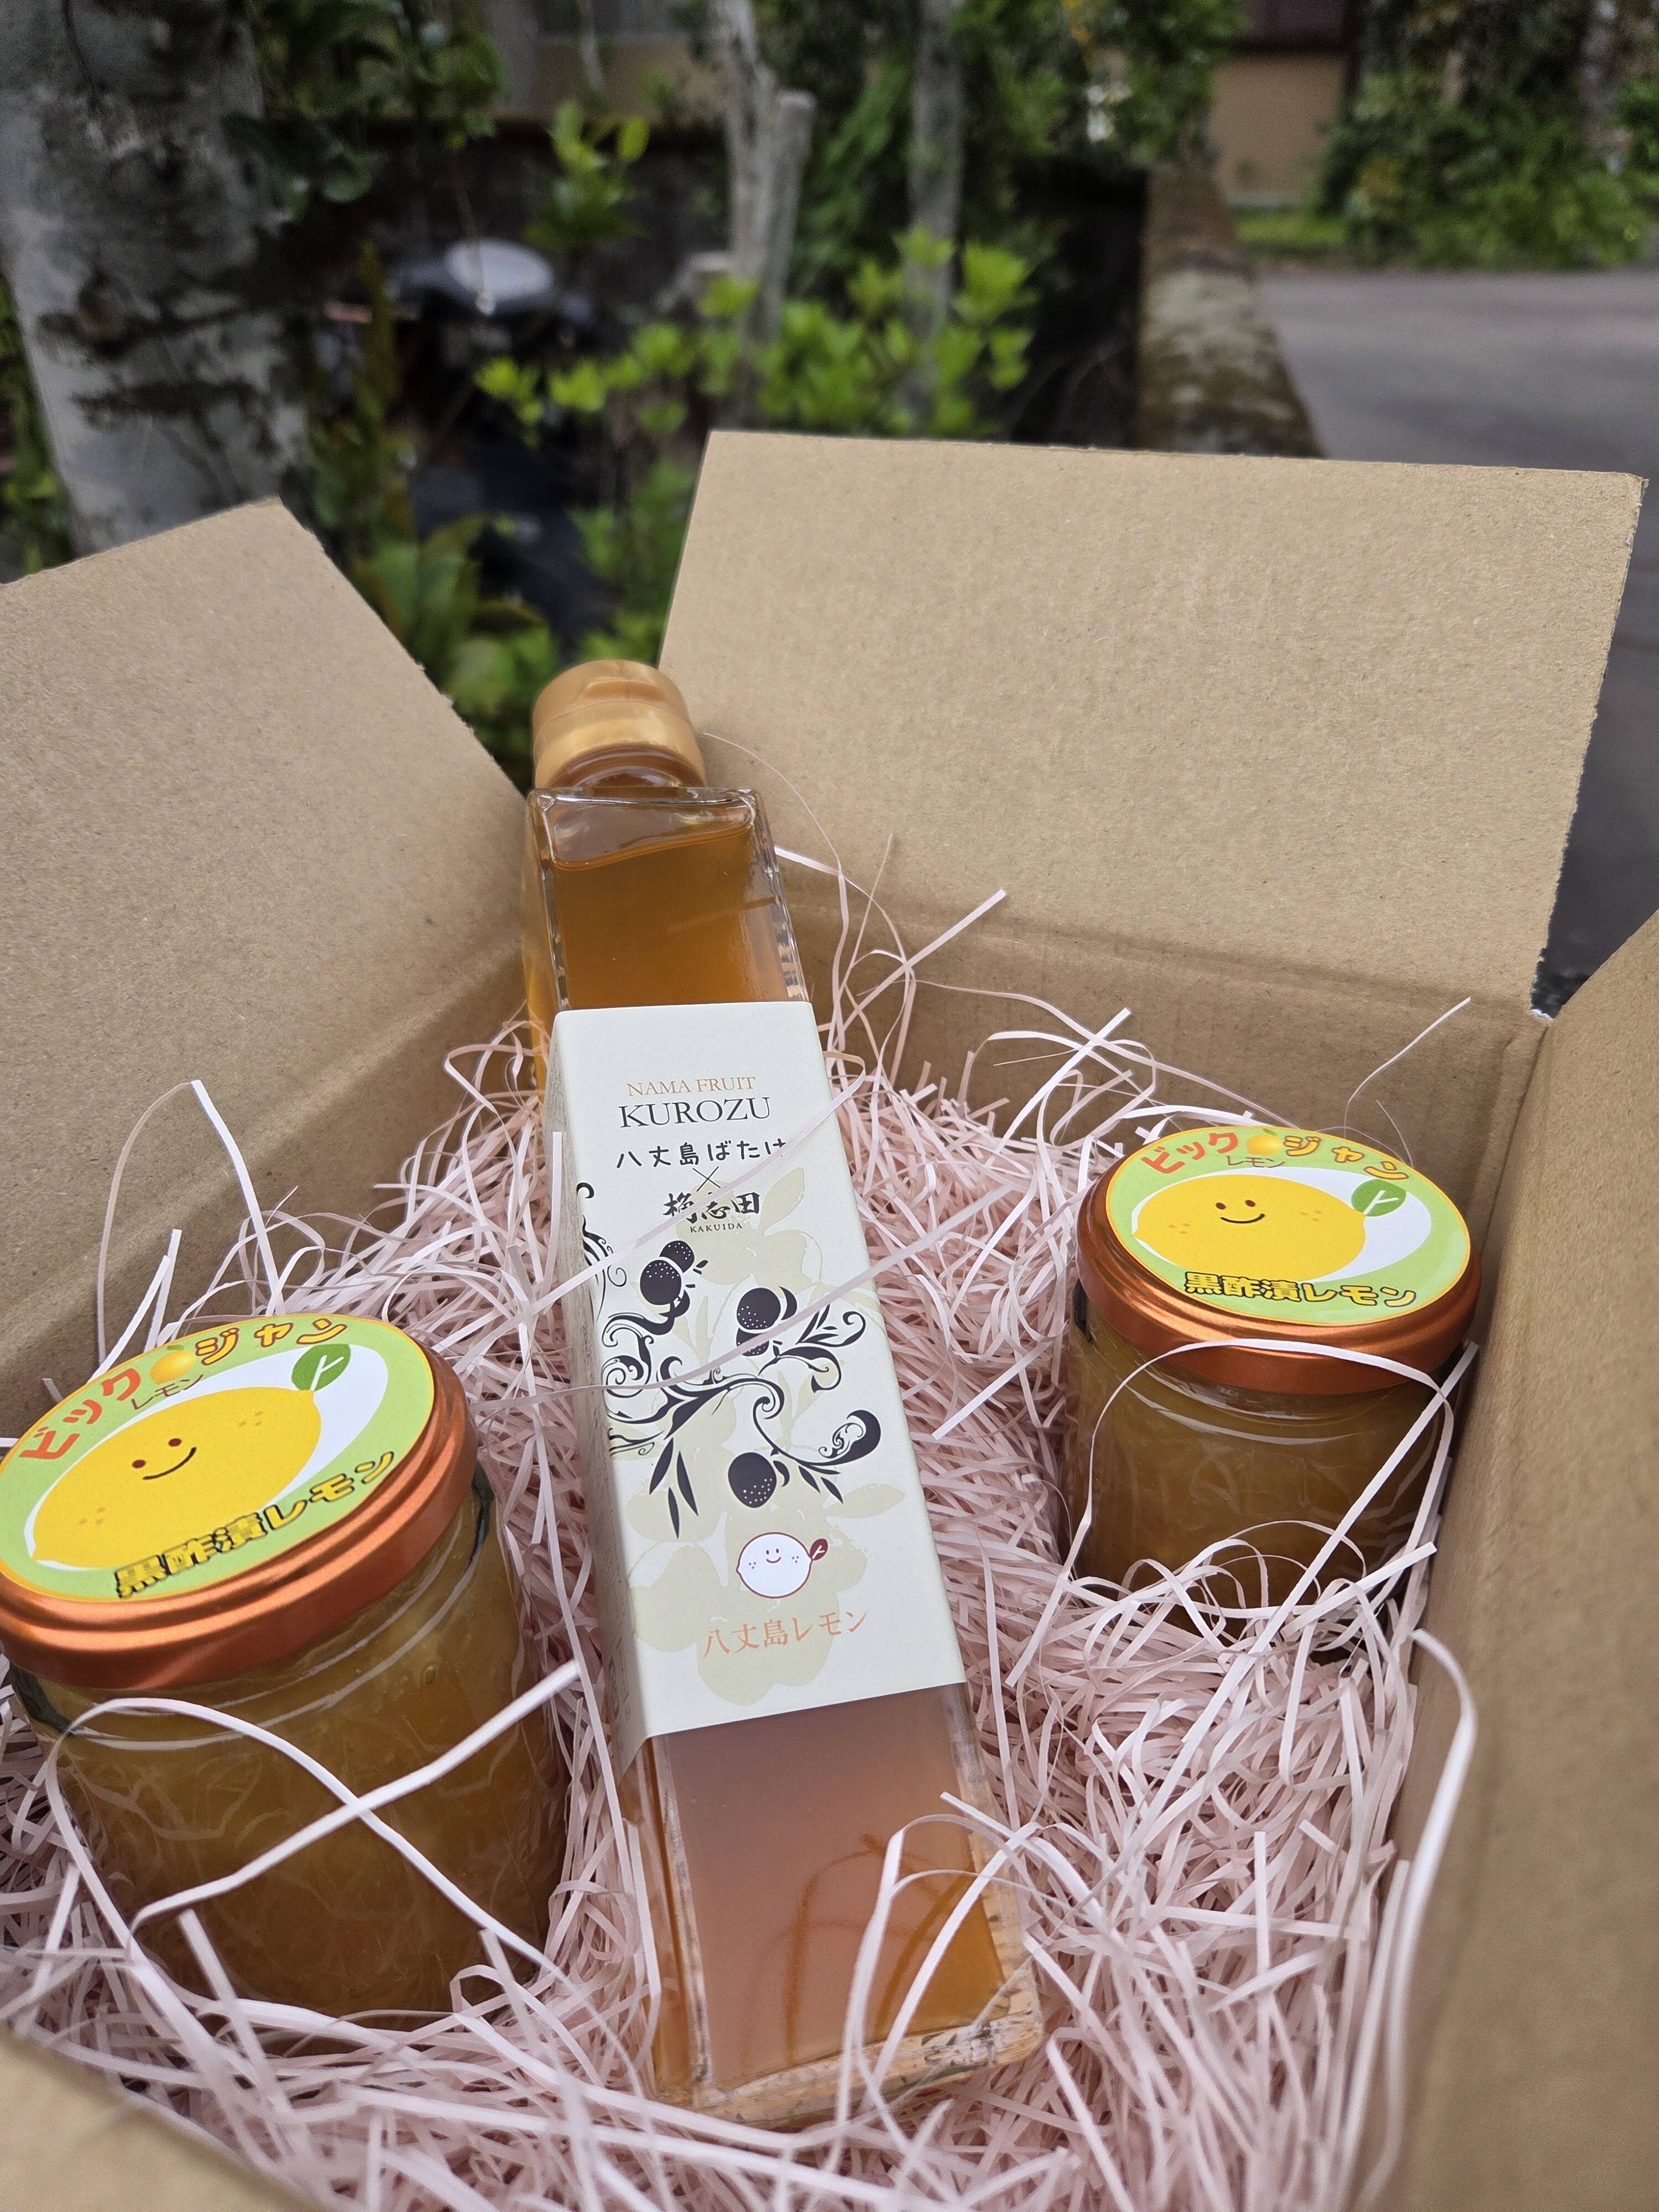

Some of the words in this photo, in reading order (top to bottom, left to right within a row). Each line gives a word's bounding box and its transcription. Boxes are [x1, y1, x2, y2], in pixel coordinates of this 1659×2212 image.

[626, 1079, 691, 1097] NAMA
[696, 1076, 756, 1093] FRUIT
[618, 1097, 771, 1129] KUROZU
[616, 1138, 786, 1169] 八丈島ばたけ
[1225, 1154, 1286, 1169] レモン
[690, 1222, 743, 1233] KAKUIDA
[1183, 1271, 1417, 1308] 黒酢漬レモン
[131, 1374, 205, 1411] レモン
[114, 1451, 394, 1598] 黒酢漬レモン
[703, 1610, 868, 1658] 八丈島レモン
